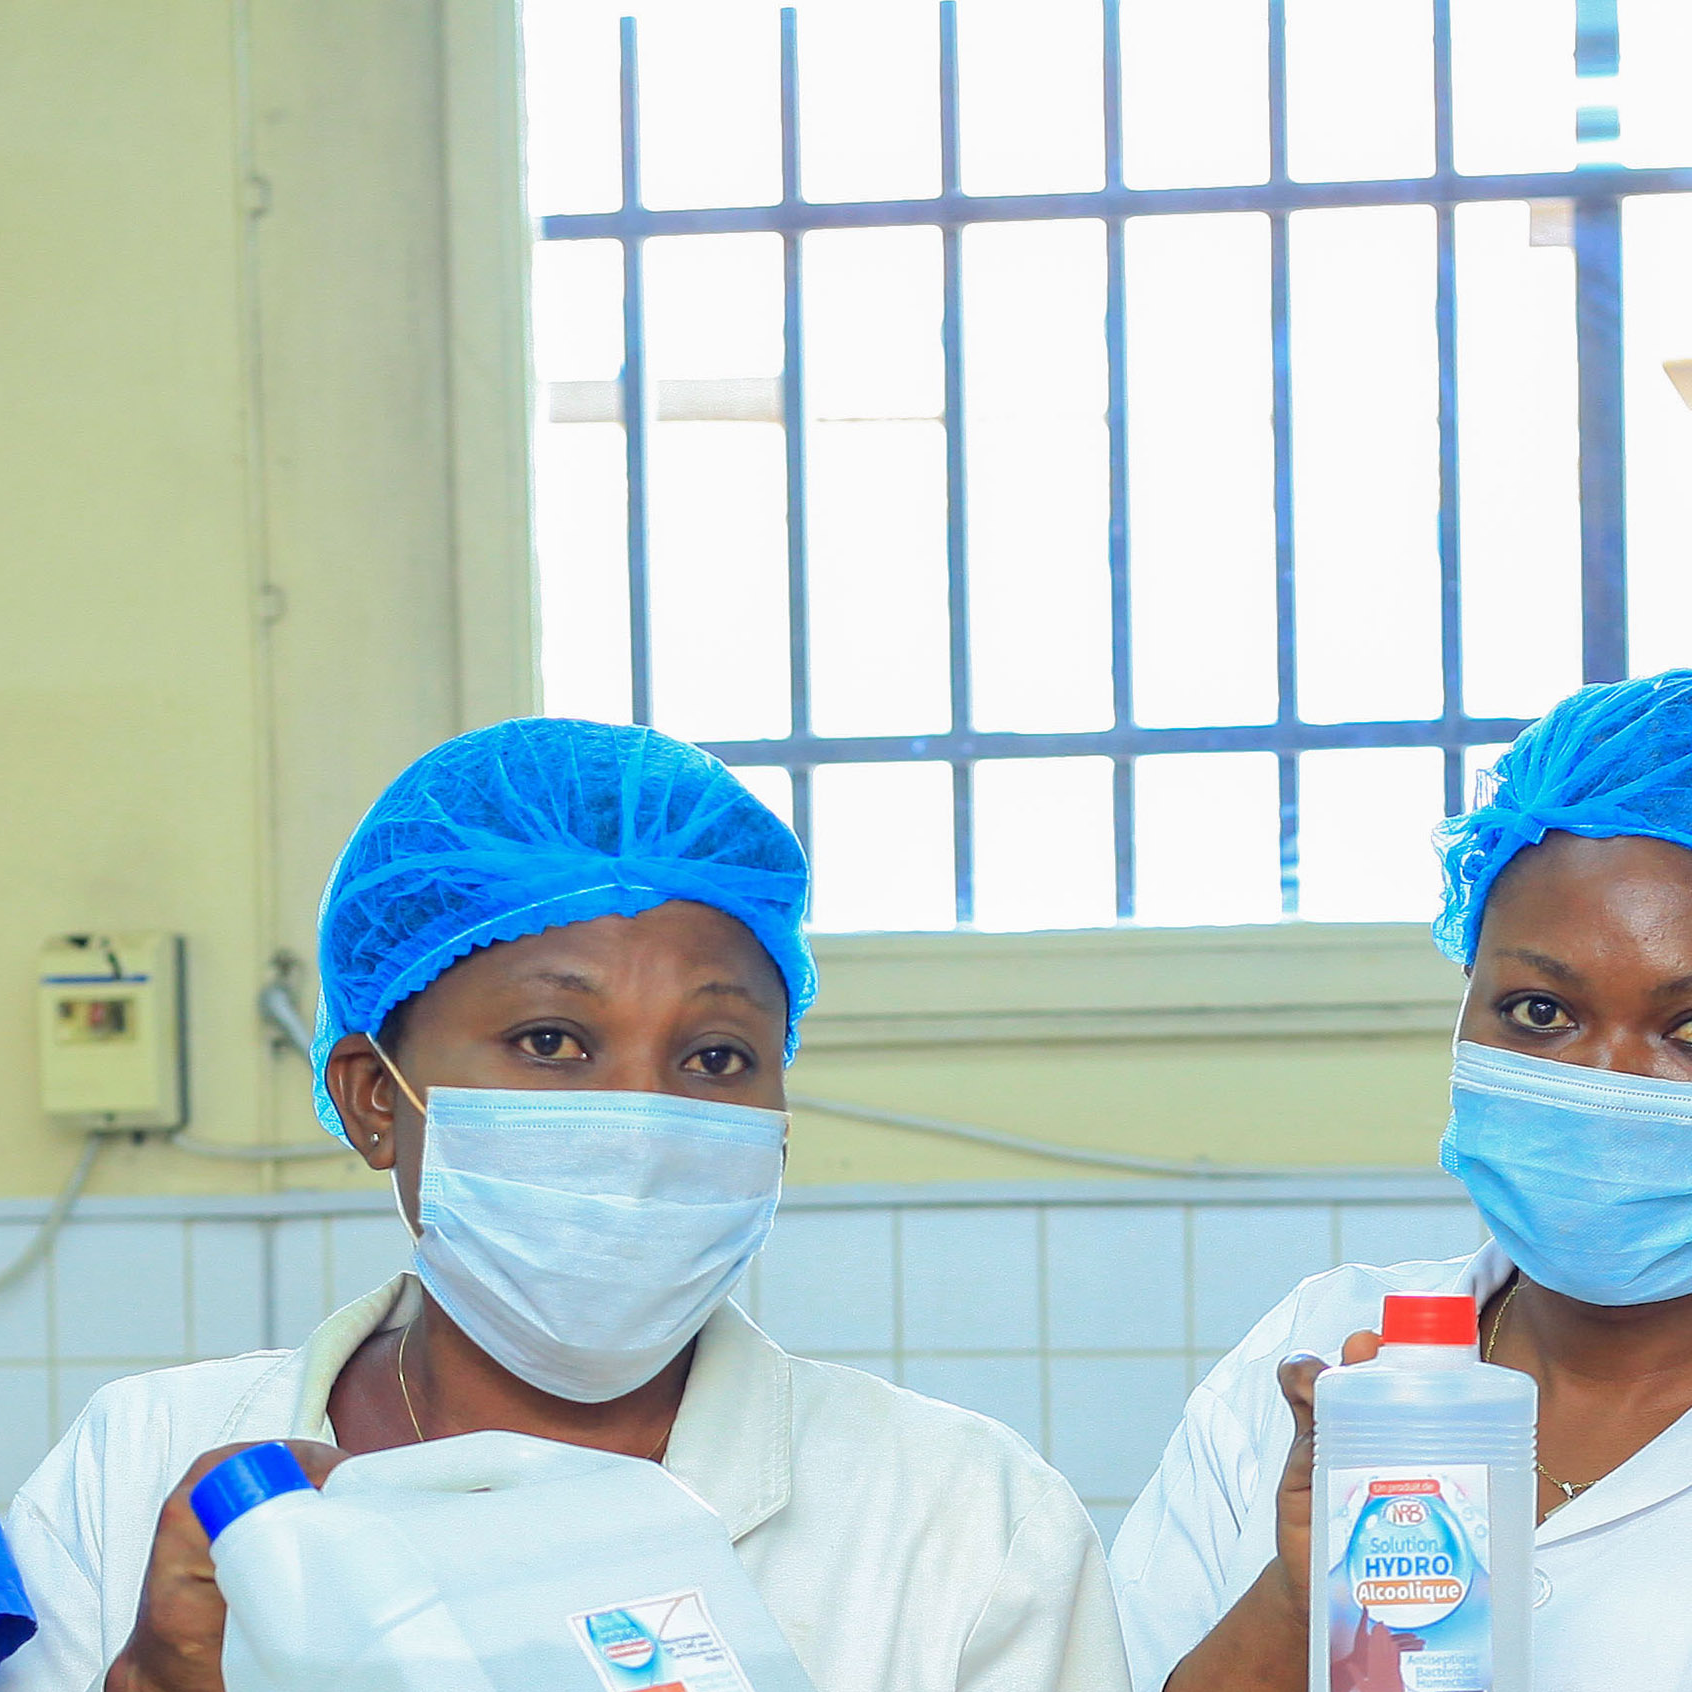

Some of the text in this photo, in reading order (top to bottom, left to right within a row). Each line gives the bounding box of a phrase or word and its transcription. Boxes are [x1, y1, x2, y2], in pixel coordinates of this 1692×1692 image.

[1370, 1536, 1438, 1553] Solution
[1365, 1555, 1450, 1577] HYDRO
[1358, 1581, 1460, 1603] Alcoolique
